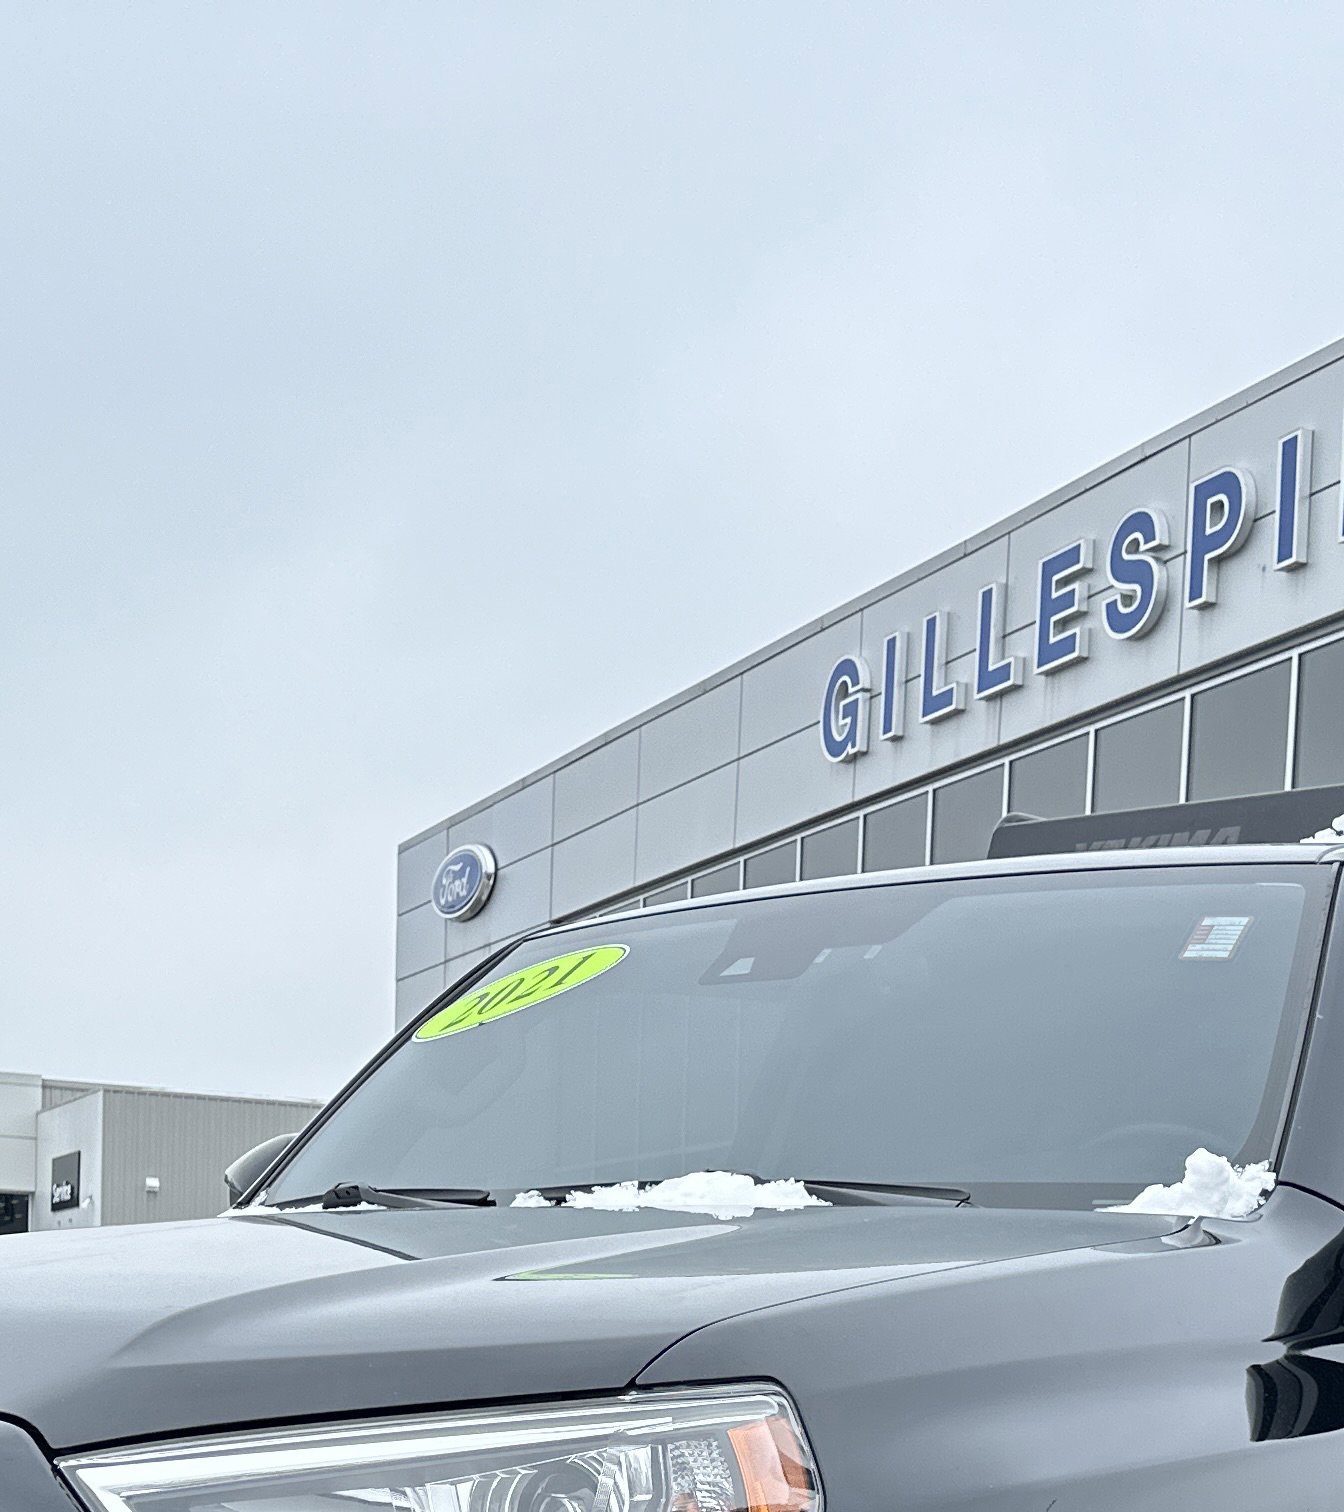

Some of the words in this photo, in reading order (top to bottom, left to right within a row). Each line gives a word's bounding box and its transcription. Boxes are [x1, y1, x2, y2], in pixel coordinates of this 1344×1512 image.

[1075, 826, 1241, 850] KIMA
[438, 862, 471, 906] Ford
[439, 951, 597, 1032] 2021
